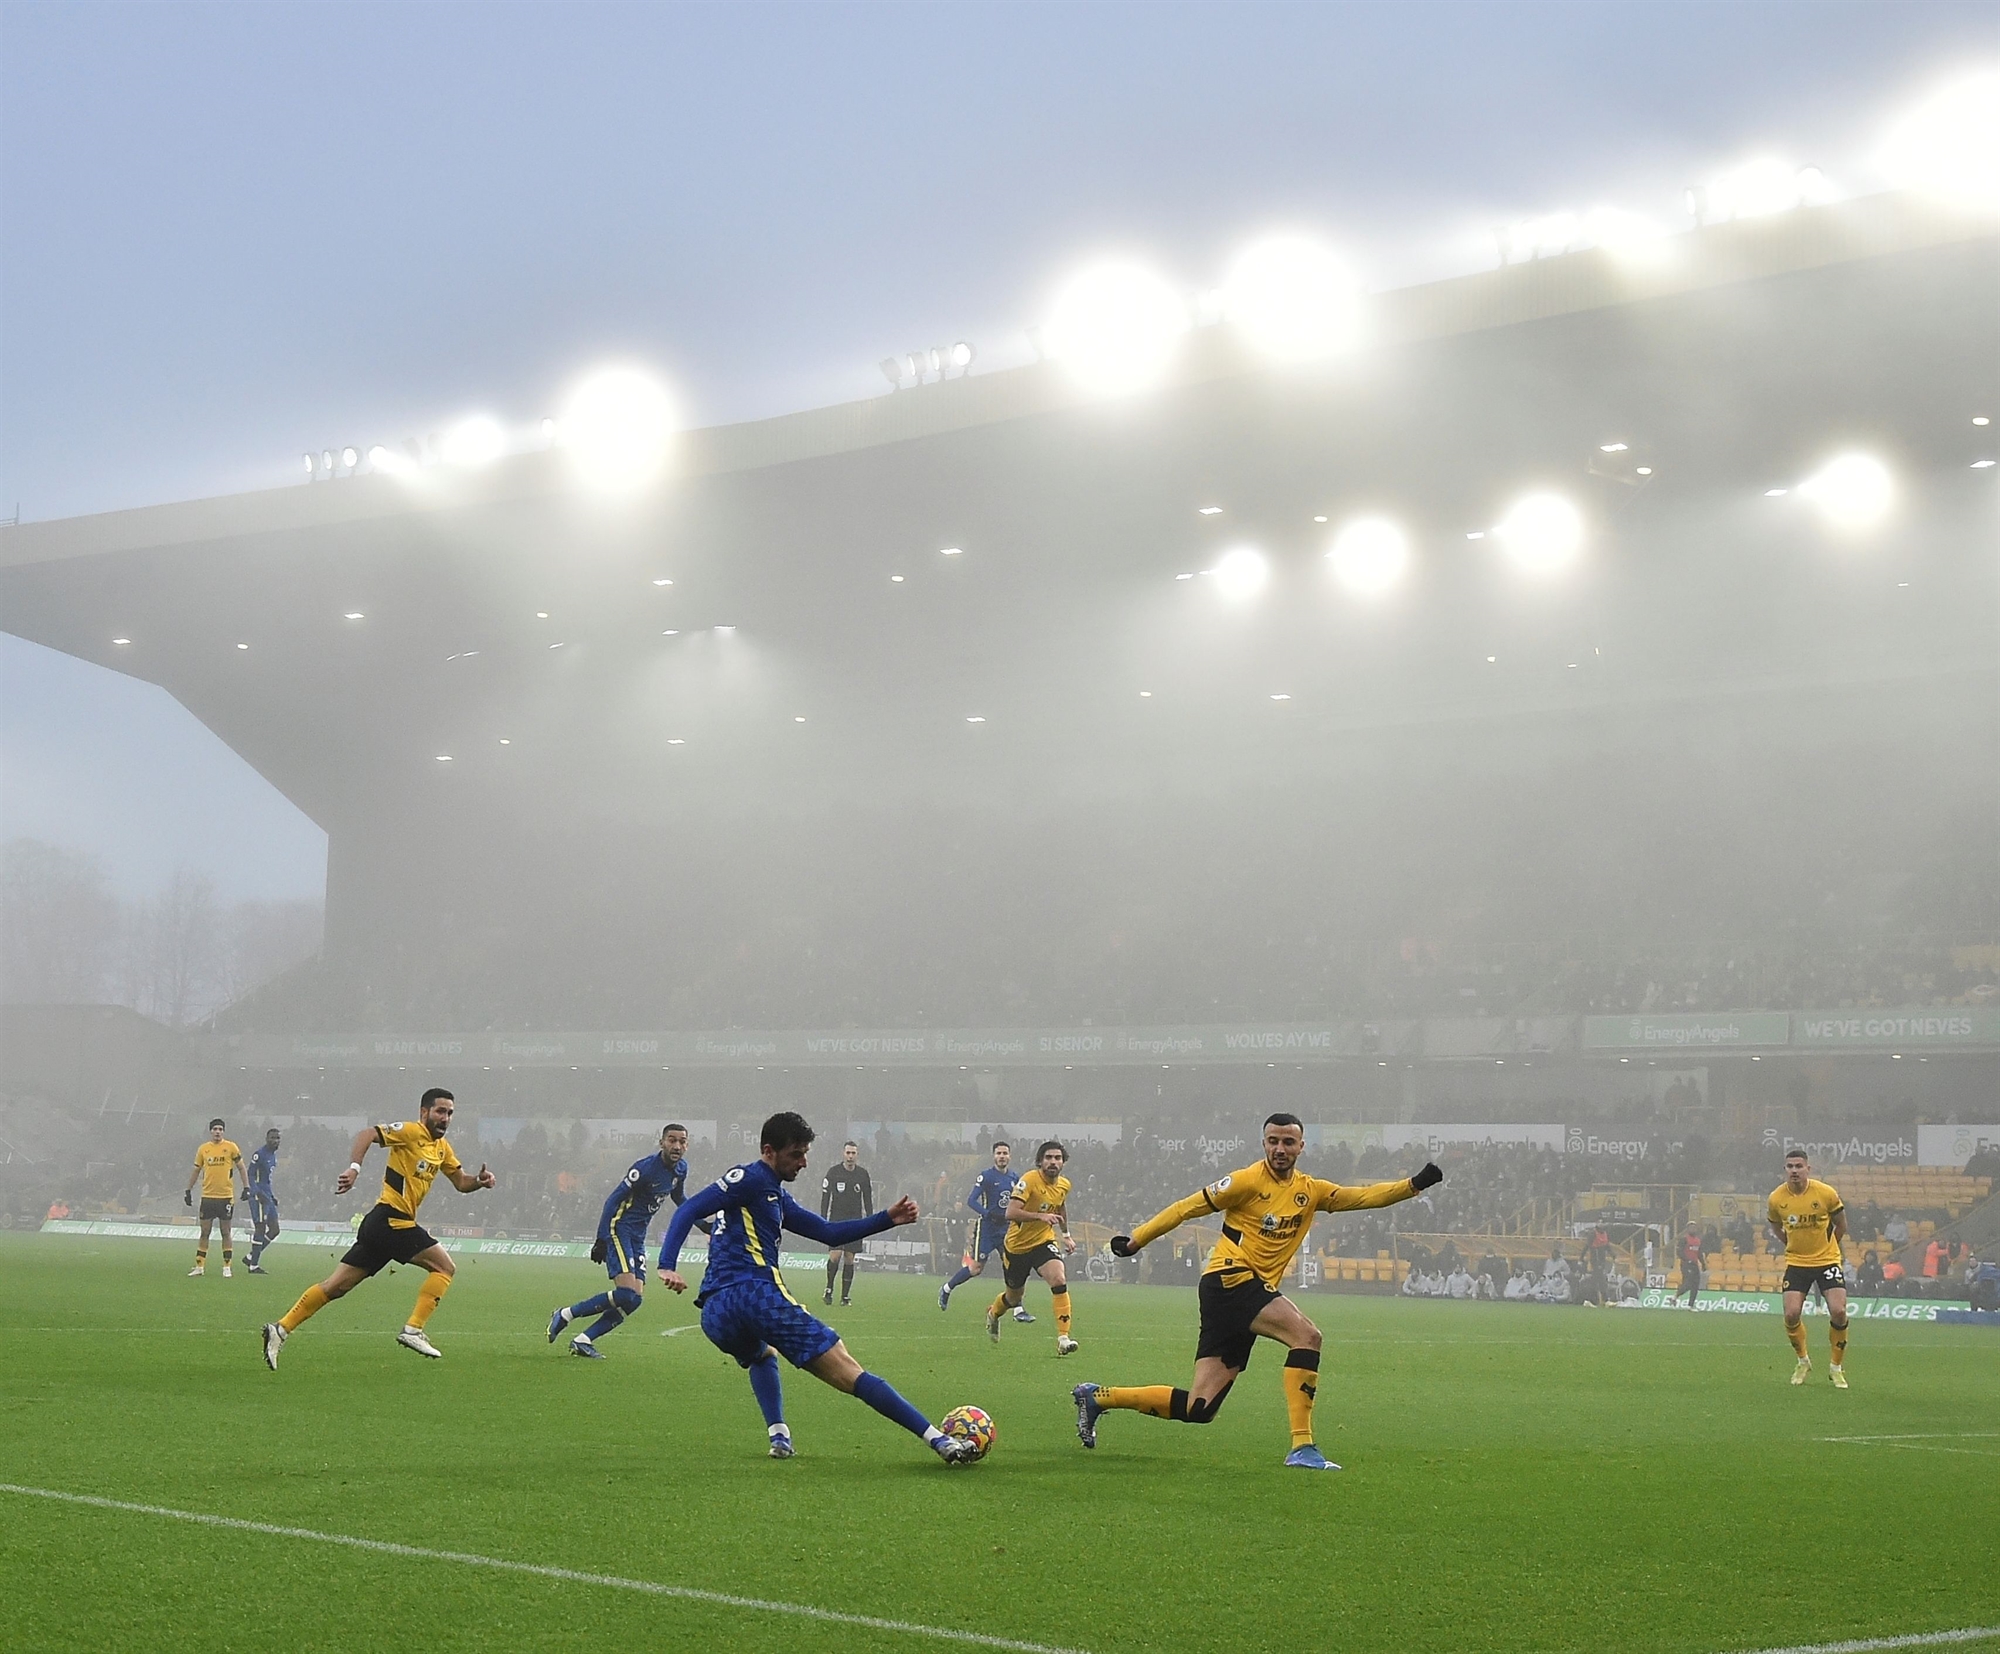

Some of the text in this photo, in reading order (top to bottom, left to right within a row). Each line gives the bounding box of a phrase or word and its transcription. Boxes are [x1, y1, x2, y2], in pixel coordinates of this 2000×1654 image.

[1644, 1023, 1740, 1044] EnergyAngels
[1804, 1017, 1972, 1038] WE'VE GOT NEVES
[850, 1038, 880, 1053] GOT
[881, 1038, 924, 1052] NEVES
[1054, 1036, 1103, 1051] SENOR
[1128, 1036, 1203, 1053] EnergyAngels
[1225, 1033, 1284, 1049] WOLVES
[1285, 1032, 1306, 1048] AY
[225, 1203, 232, 1213] 9
[479, 1242, 568, 1257] WE'VE GOT NEVES
[1047, 1243, 1059, 1253] 8
[1823, 1266, 1843, 1280] 32
[1650, 1276, 1664, 1287] 34
[1863, 1303, 1938, 1320] LAGE'S
